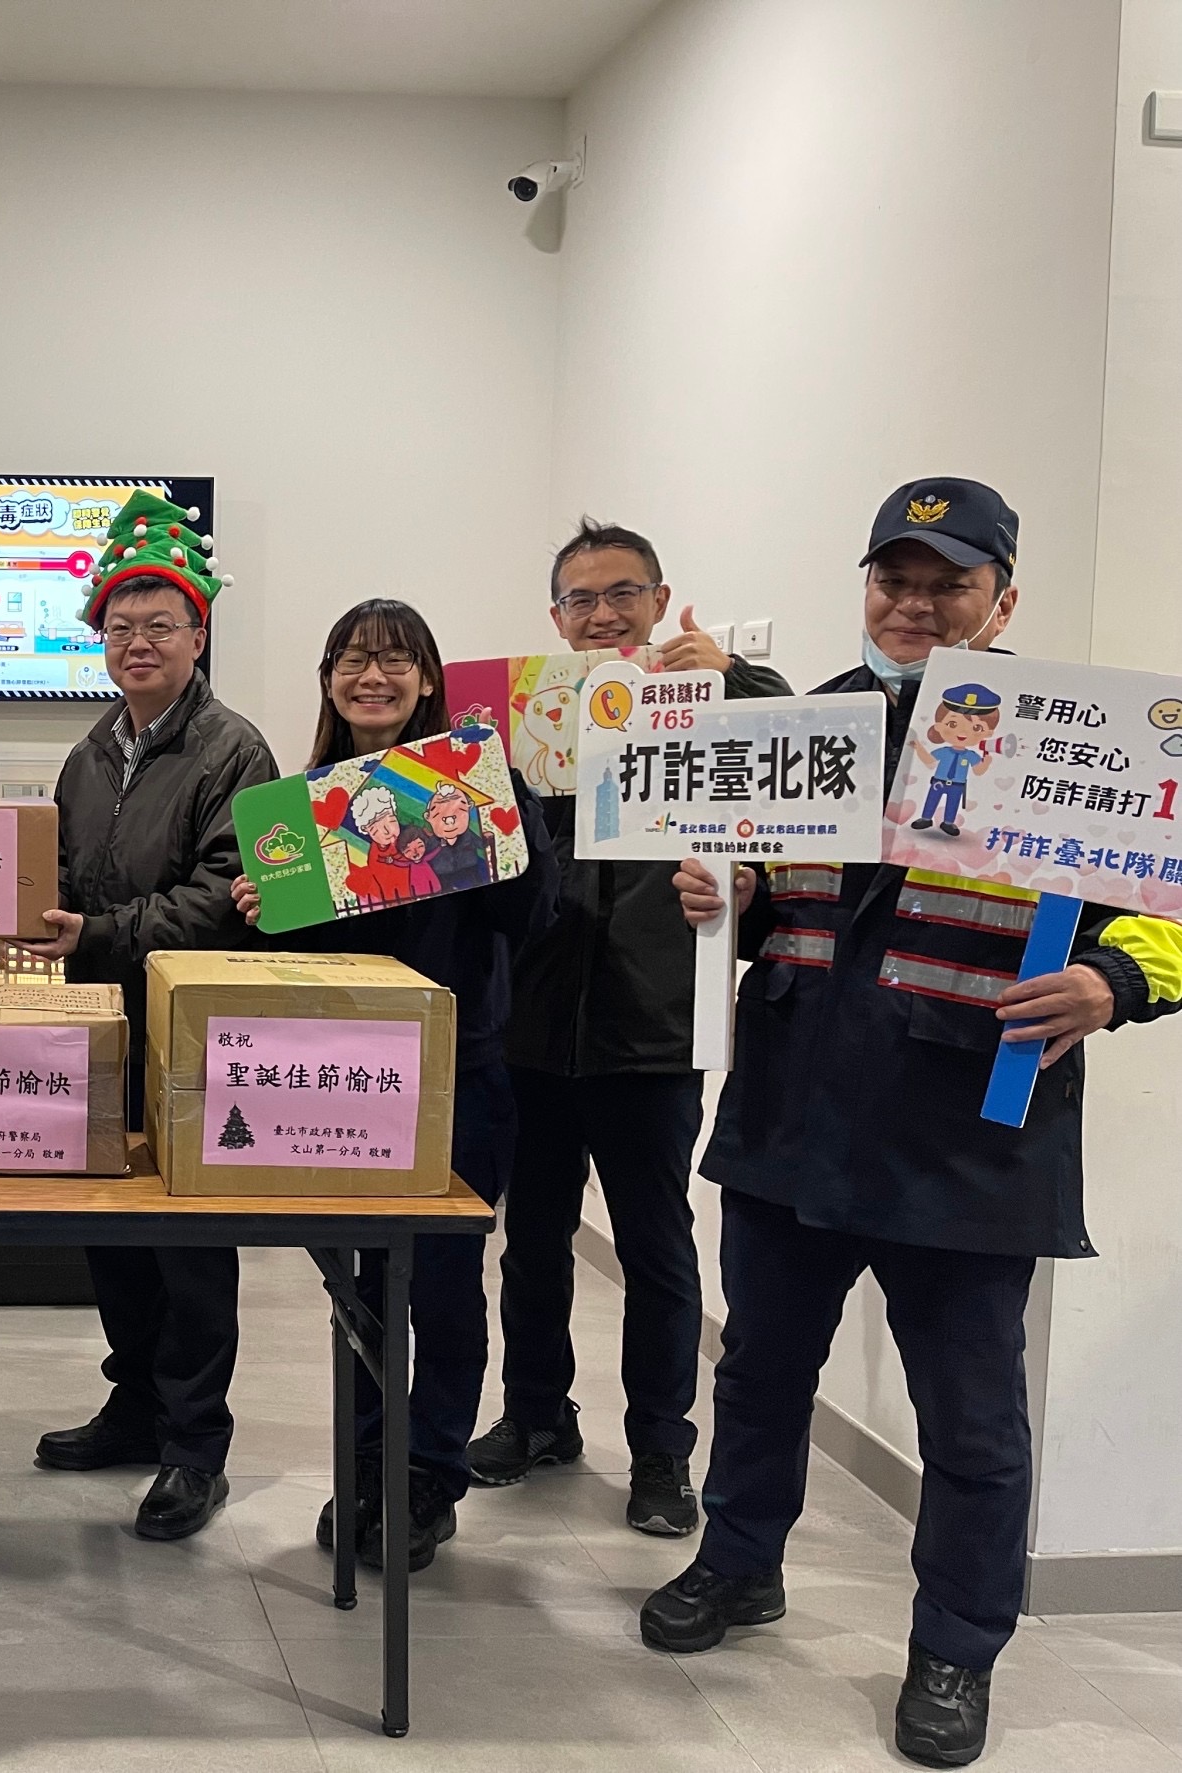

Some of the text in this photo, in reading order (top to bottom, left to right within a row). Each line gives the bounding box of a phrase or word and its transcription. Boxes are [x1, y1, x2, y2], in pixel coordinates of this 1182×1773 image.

[641, 681, 713, 705] 反詐請打
[650, 708, 695, 731] 165
[1014, 693, 1107, 729] 警用心
[1036, 736, 1131, 773] 您安心
[619, 734, 858, 803] 打詐臺北隊
[679, 824, 727, 835] 臺北市政府
[756, 824, 838, 835] 臺北市政府警察局
[691, 841, 785, 854] 守護您的財產安全
[260, 862, 312, 882] 伯大尼兒少家園
[217, 1031, 253, 1048] 敬祝
[225, 1061, 403, 1094] 聖誕佳節愉快
[273, 1124, 369, 1140] 臺北市政府警察局
[43, 1146, 65, 1160] 敬贈
[290, 1143, 392, 1160] 文山第一分局 敬贈
